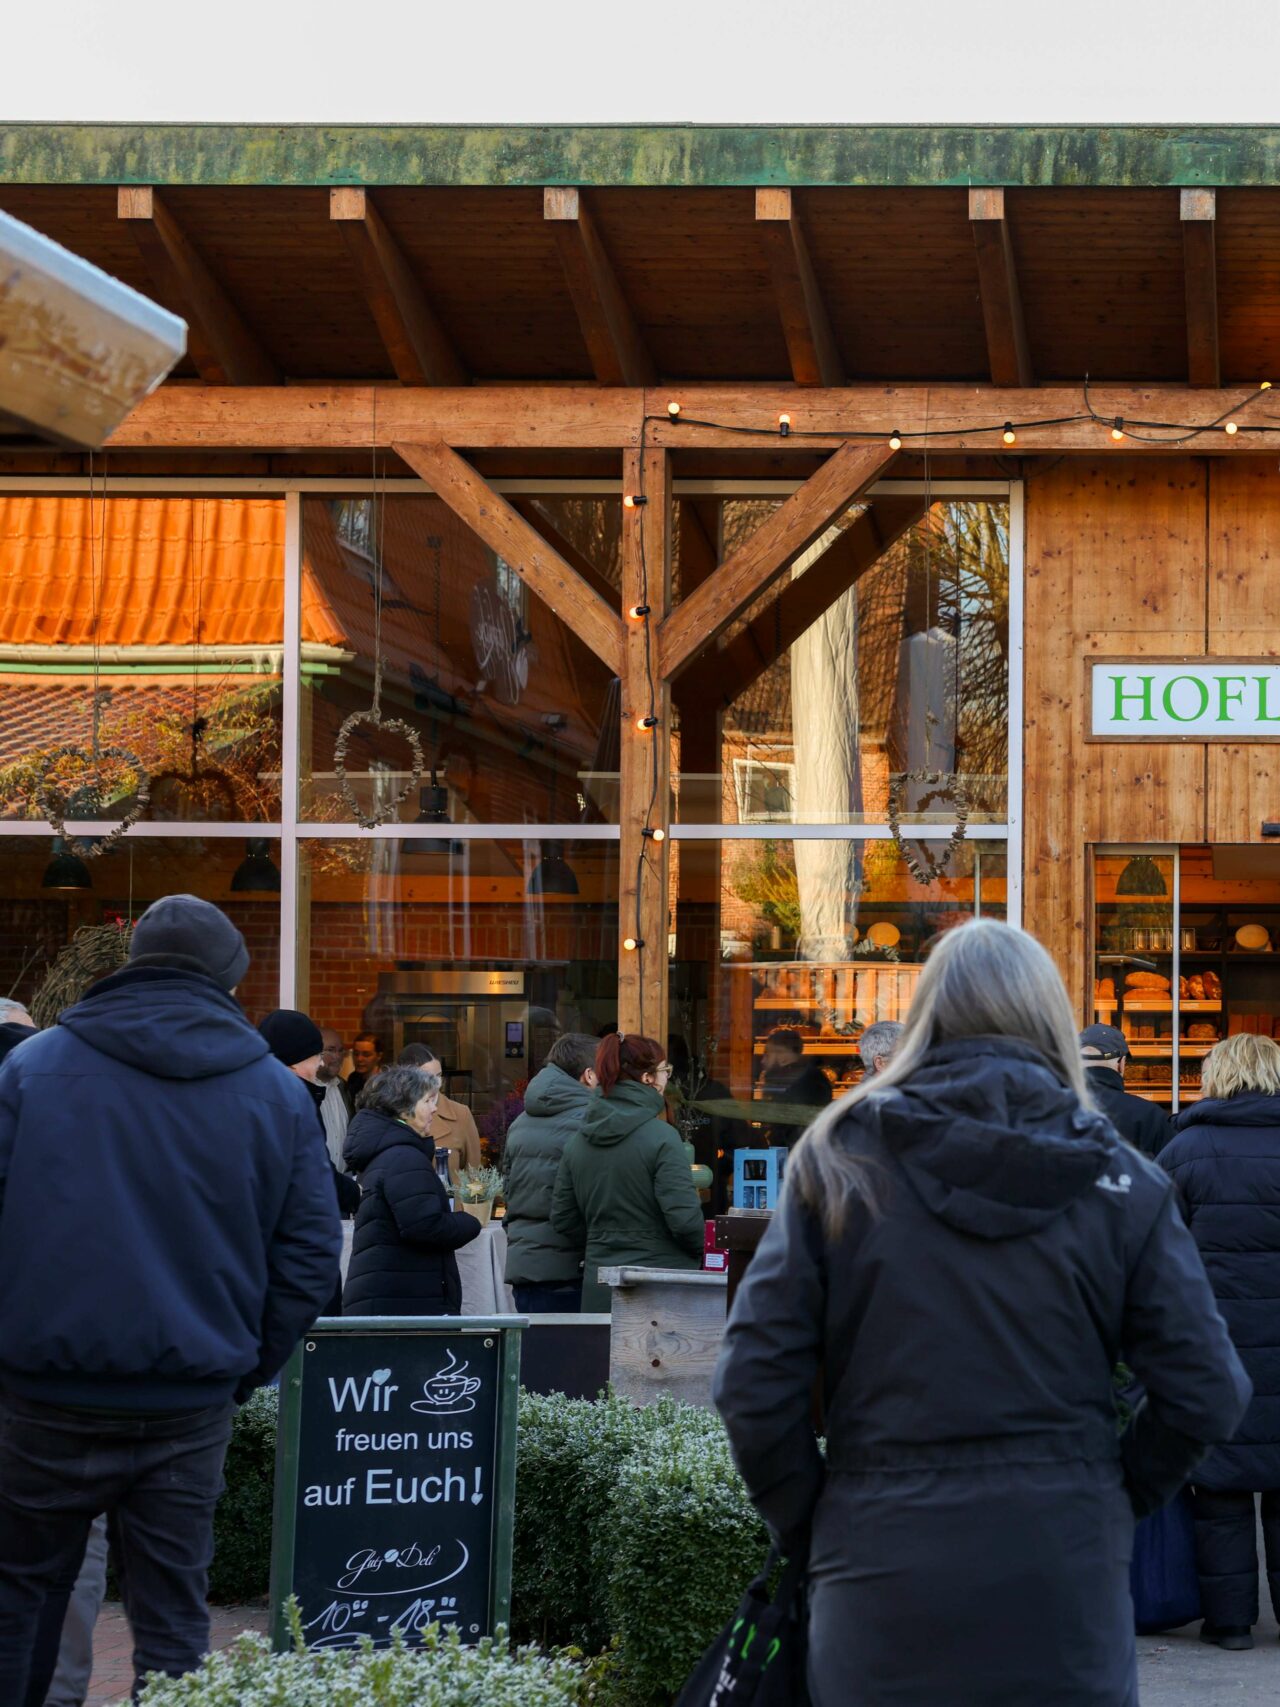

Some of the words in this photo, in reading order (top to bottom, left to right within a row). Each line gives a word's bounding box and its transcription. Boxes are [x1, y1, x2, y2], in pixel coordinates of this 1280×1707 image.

[328, 1368, 399, 1413] Wir
[335, 1427, 419, 1452] freuen
[427, 1431, 474, 1450] uns
[303, 1477, 357, 1507] auf
[365, 1466, 484, 1506] Euch!
[396, 1542, 441, 1568] Deli
